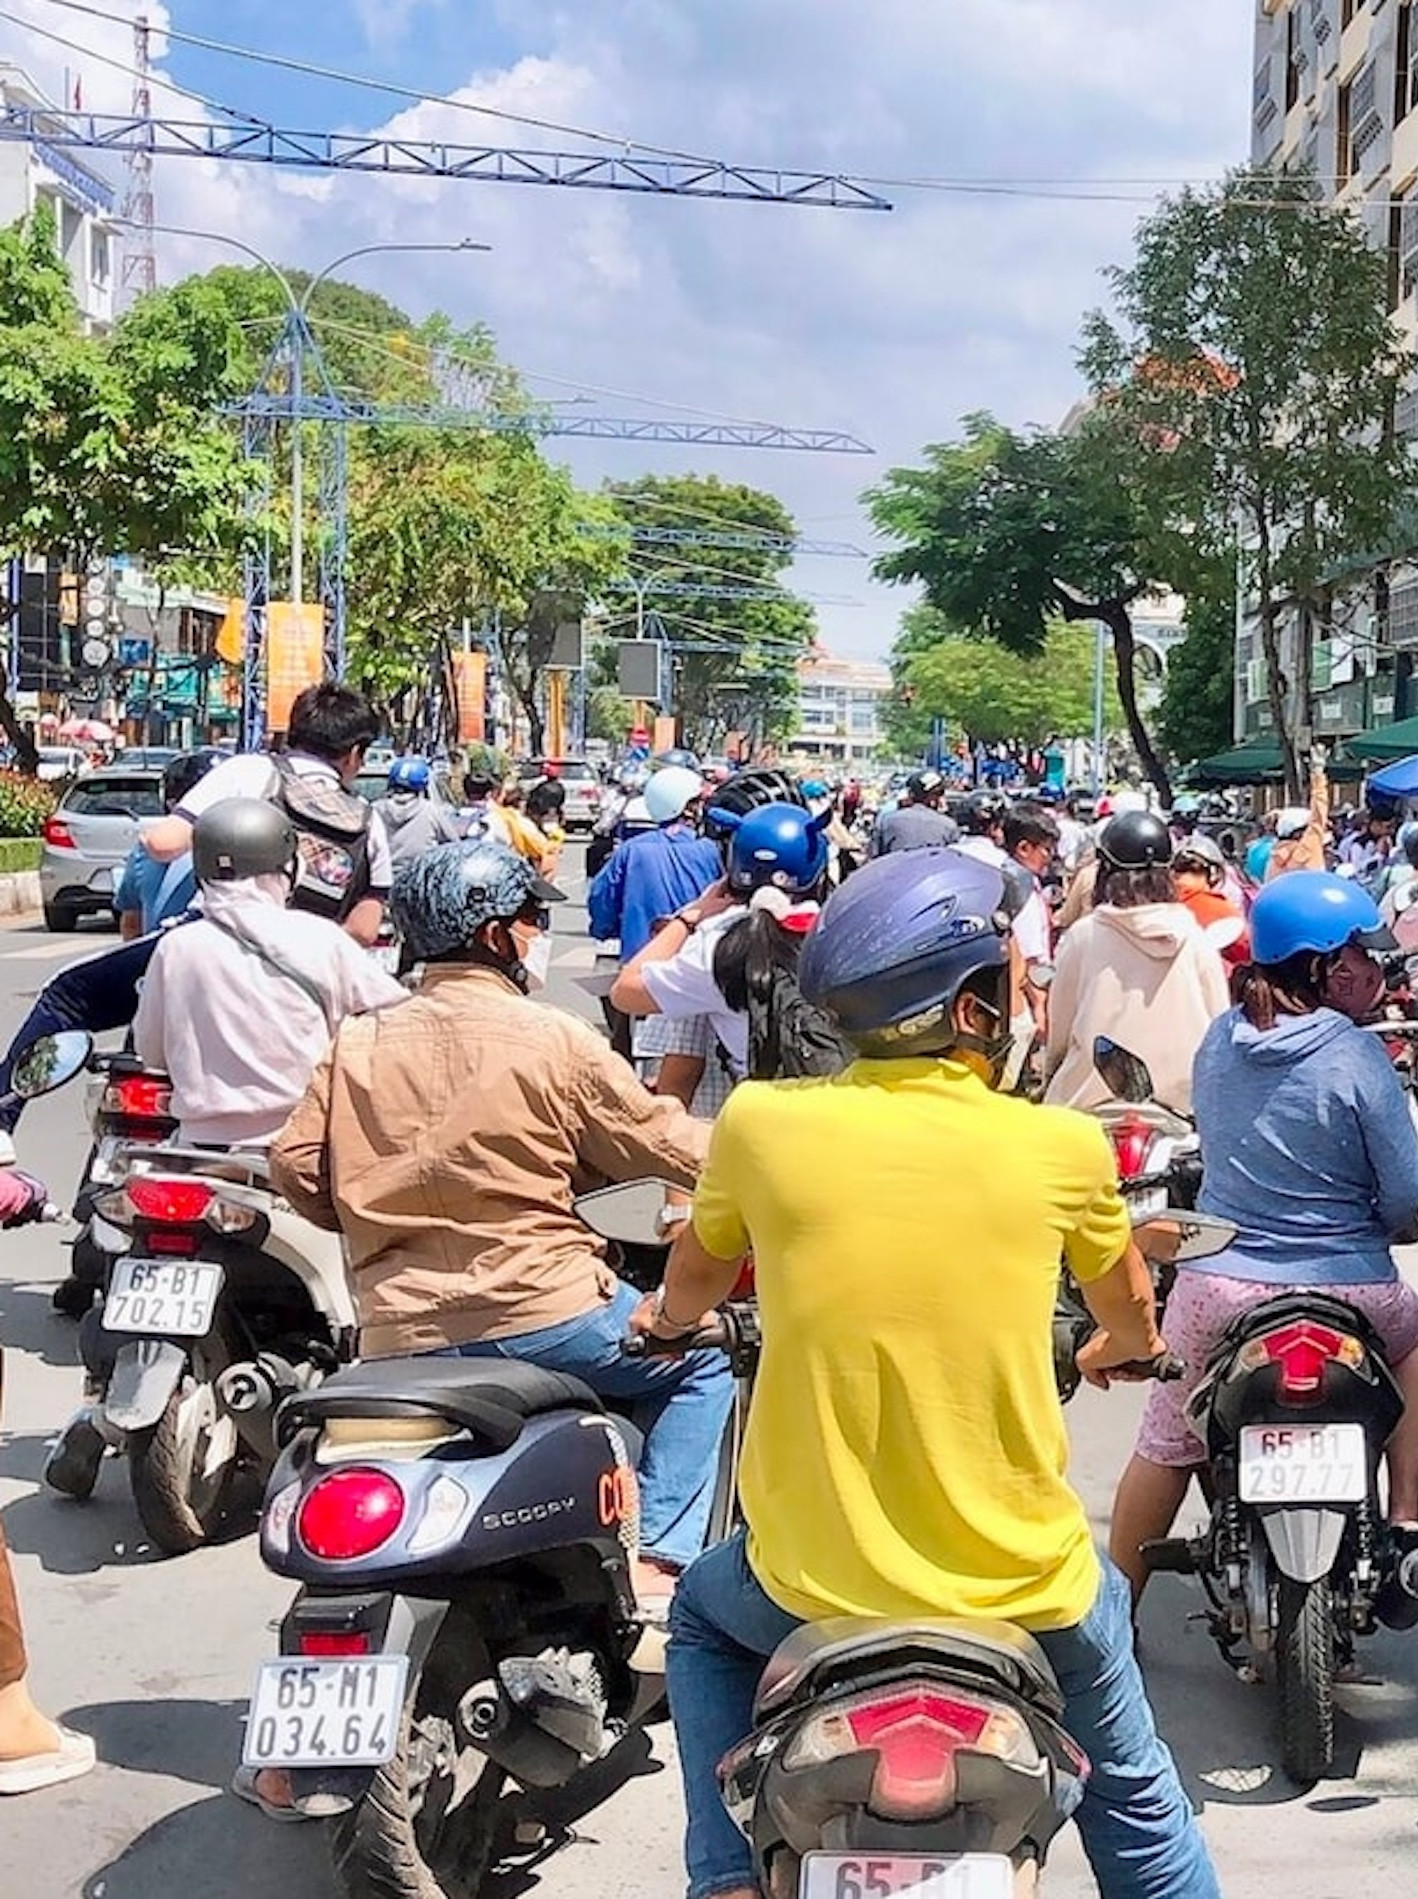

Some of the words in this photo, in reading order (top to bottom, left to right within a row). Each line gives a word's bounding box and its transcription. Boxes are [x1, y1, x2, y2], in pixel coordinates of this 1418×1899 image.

[112, 1296, 206, 1330] 702.15
[1249, 1462, 1355, 1498] 297.77
[482, 1495, 577, 1531] SCOOPY
[256, 1713, 386, 1758] 034.64
